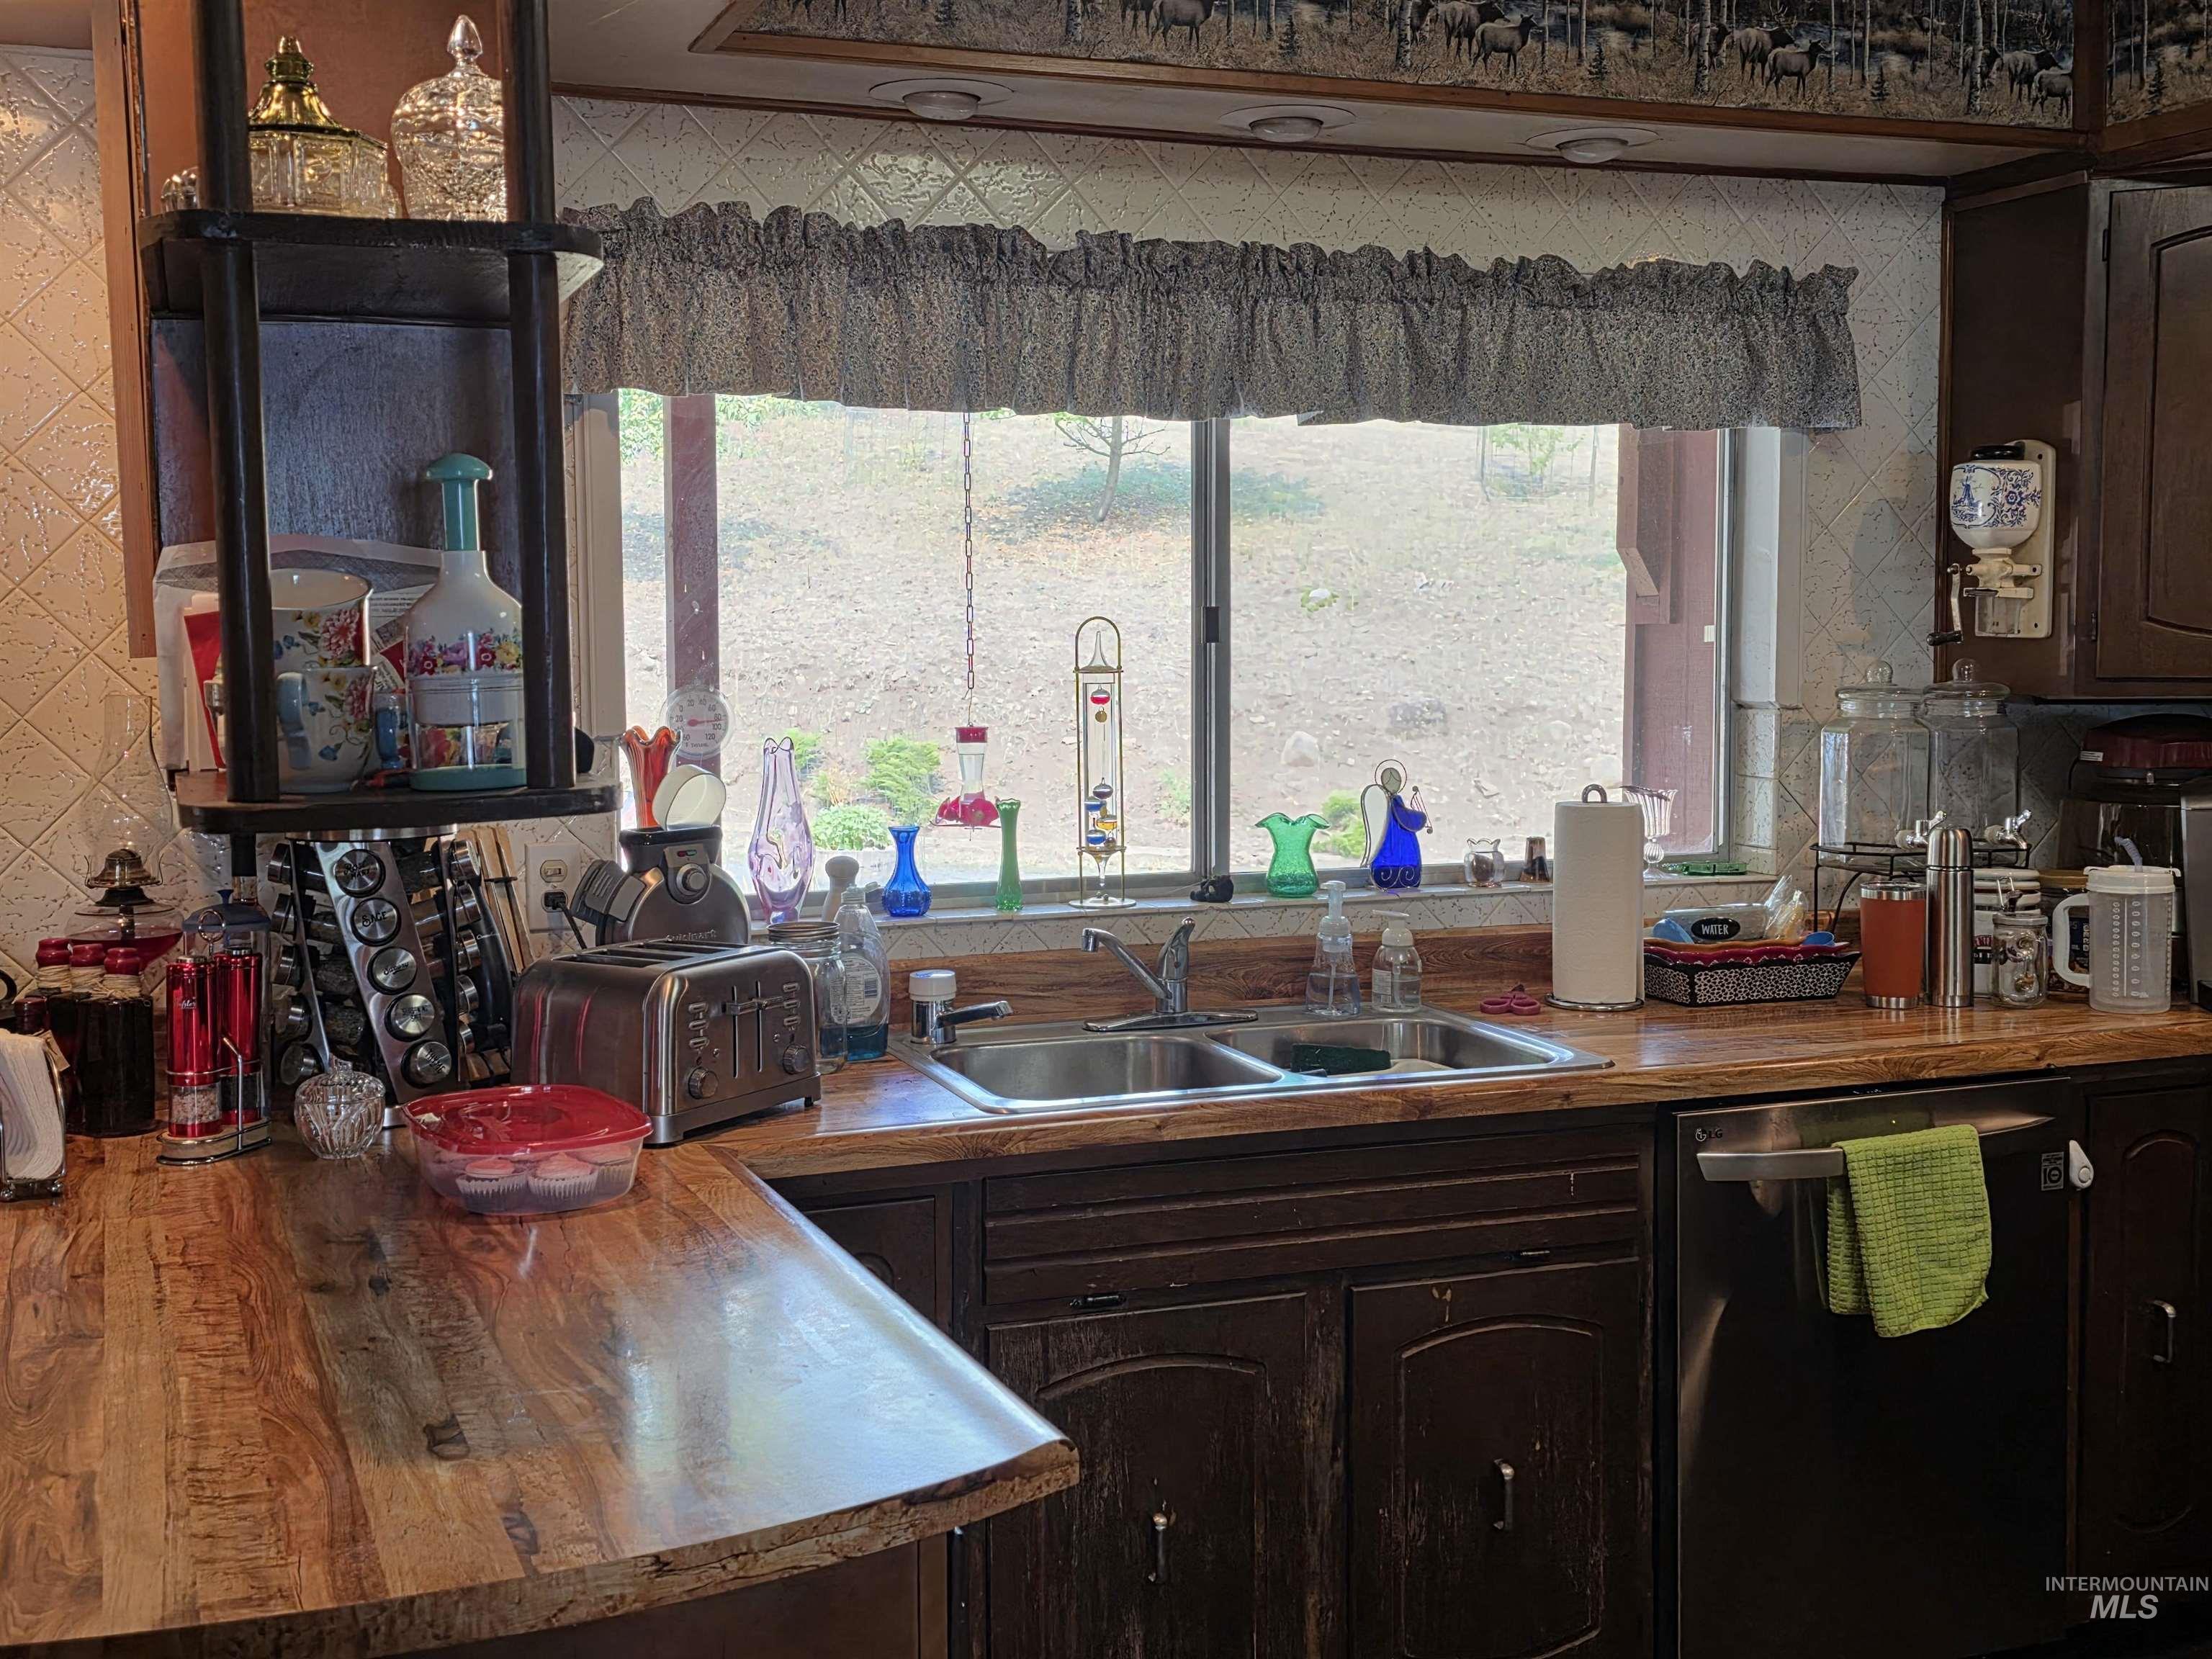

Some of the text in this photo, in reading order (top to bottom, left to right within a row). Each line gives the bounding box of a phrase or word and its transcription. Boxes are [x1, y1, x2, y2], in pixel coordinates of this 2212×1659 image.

[361, 911, 387, 927] SAGE
[1701, 924, 1729, 935] WATER
[1708, 1128, 1723, 1139] LG
